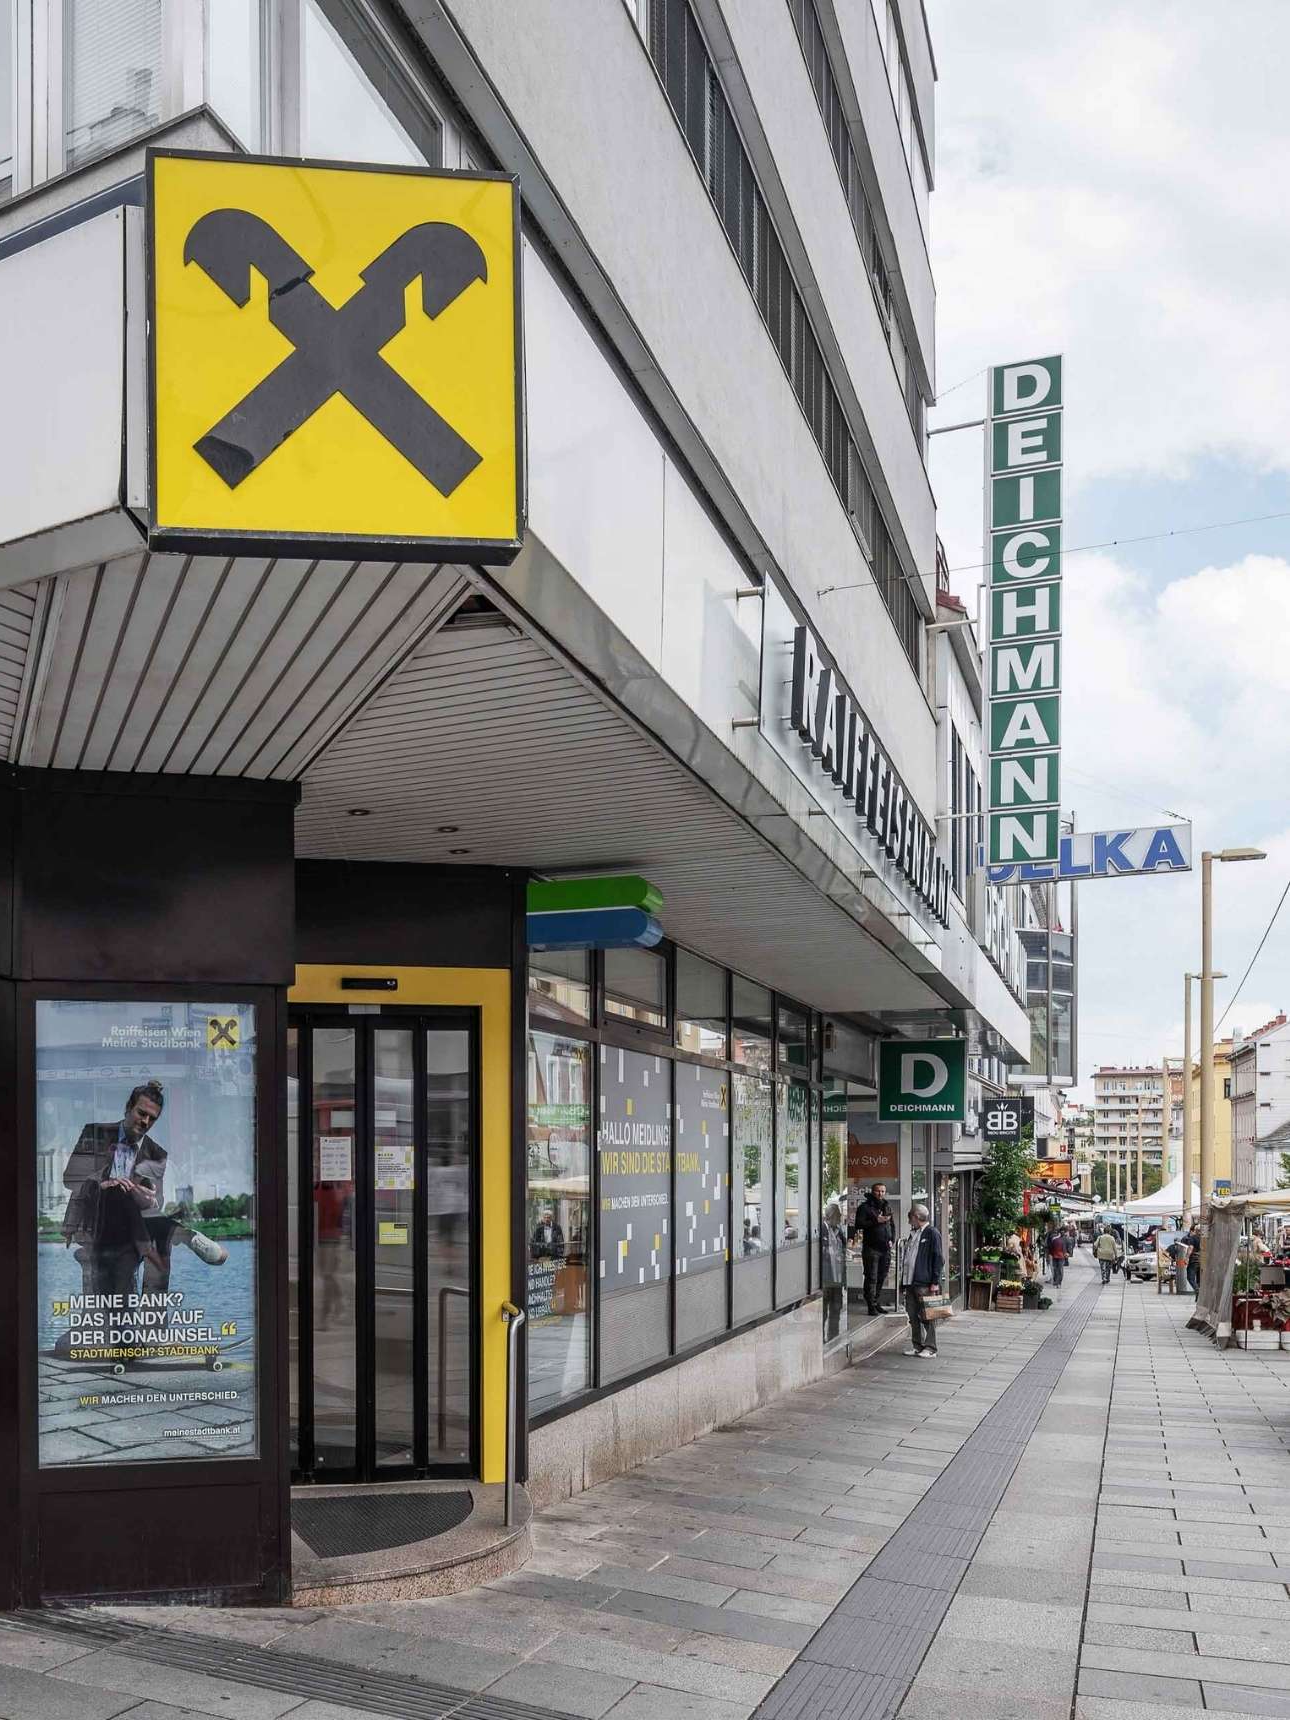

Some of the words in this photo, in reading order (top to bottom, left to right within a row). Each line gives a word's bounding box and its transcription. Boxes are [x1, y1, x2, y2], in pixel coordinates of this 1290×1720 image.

[999, 362, 1055, 861] DEICHMANN
[111, 1026, 167, 1037] Raiffeisen
[171, 1027, 201, 1037] Wien
[102, 1037, 137, 1048] Meine
[141, 1037, 201, 1048] Stadtbank
[900, 1053, 949, 1098] D
[889, 1103, 956, 1113] DEICHMANN
[602, 1121, 630, 1145] HALLO
[602, 1152, 619, 1175] WIR
[621, 1152, 641, 1175] SIND
[642, 1152, 655, 1174] DIE
[656, 1152, 701, 1174] STATBANK.
[861, 1156, 888, 1167] Style
[70, 1295, 124, 1309] MEINE
[127, 1293, 184, 1308] BANK?
[70, 1312, 104, 1327] DAS
[109, 1311, 168, 1326] HANDY
[171, 1310, 204, 1324] AUF
[70, 1331, 104, 1346] DER
[109, 1328, 222, 1345] DONAUINSEL.
[70, 1348, 155, 1359] STADTMENSCH?
[157, 1346, 222, 1357] STADTBANK.
[79, 1396, 99, 1405] WIR
[101, 1394, 144, 1404] MACHEN
[146, 1393, 167, 1403] DEN
[169, 1391, 240, 1402] UNTERSCHIED.
[164, 1426, 241, 1437] meinestadtbank.at
